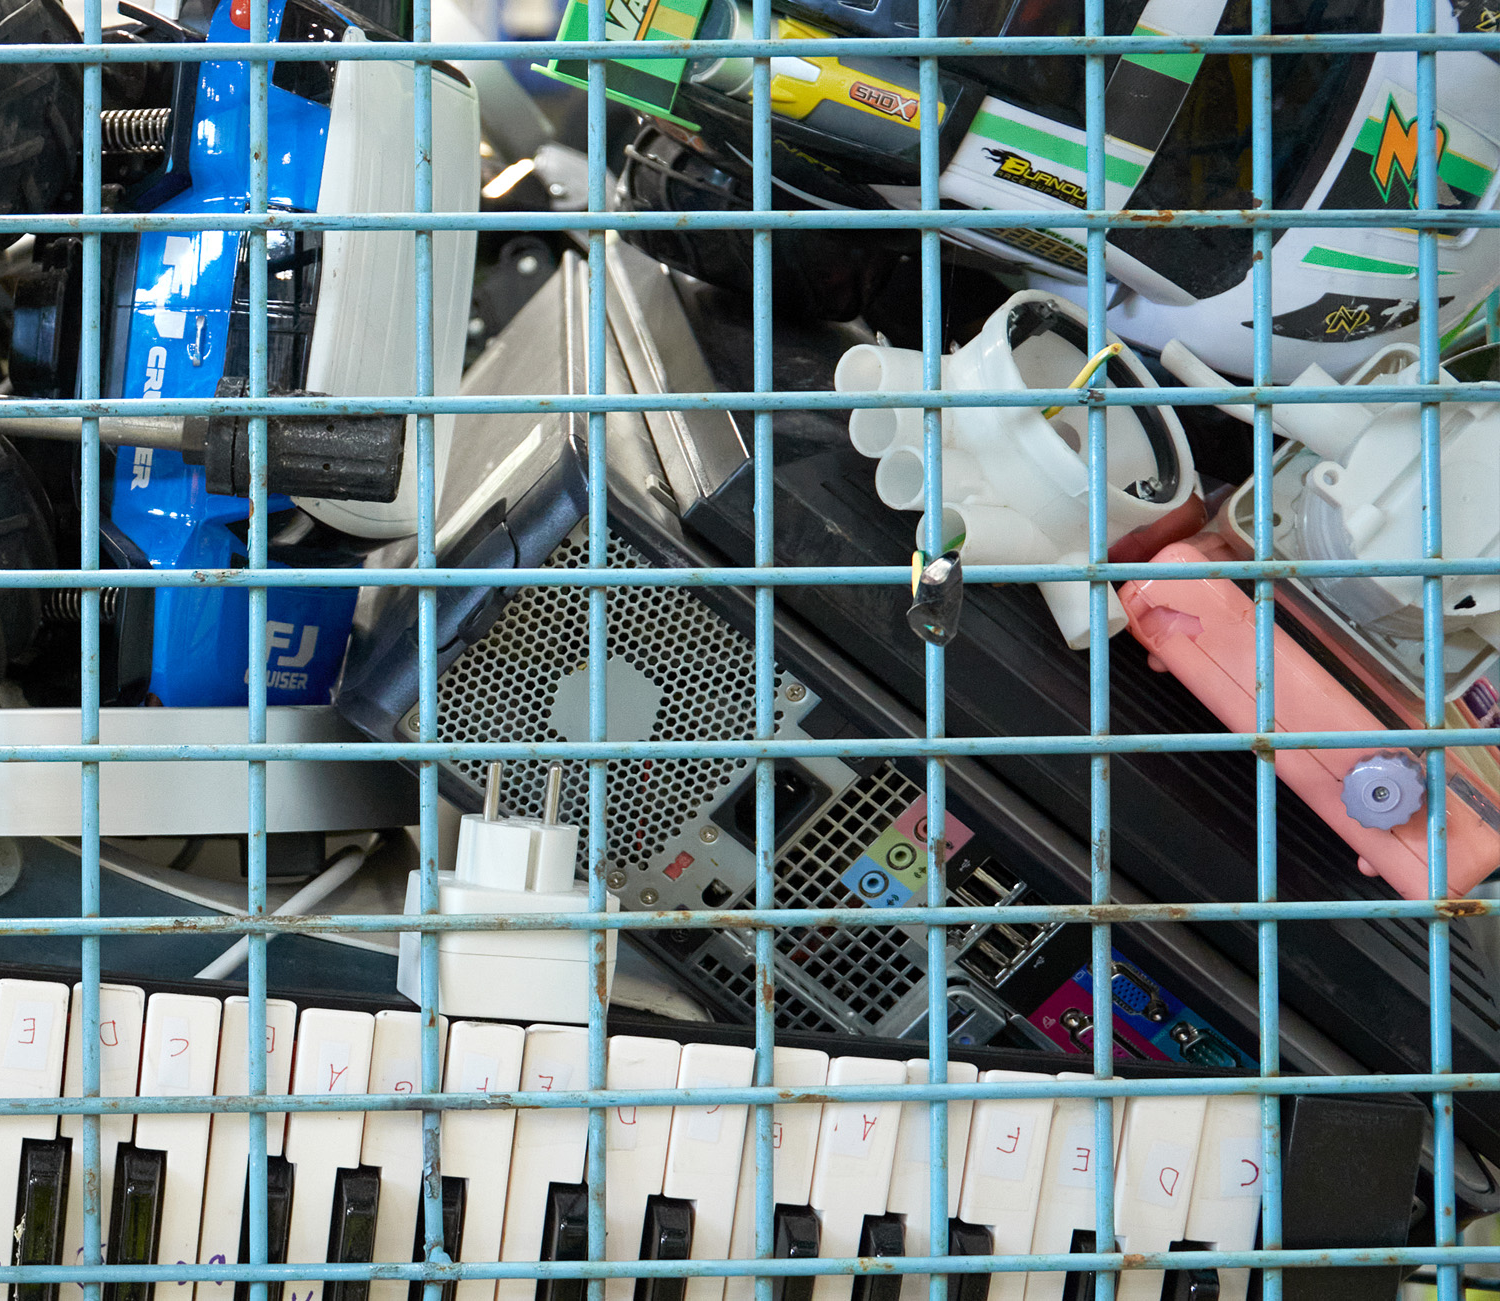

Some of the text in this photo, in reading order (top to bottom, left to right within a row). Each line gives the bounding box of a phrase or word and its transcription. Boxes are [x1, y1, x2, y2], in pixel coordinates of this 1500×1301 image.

[855, 85, 918, 120] SHOX
[1000, 156, 1088, 200] BURNOU
[1029, 180, 1088, 208] SUPPLIER
[129, 345, 169, 491] CRER
[265, 620, 320, 668] FJ
[244, 667, 309, 690] UISER
[17, 1017, 37, 1045] E
[328, 1063, 349, 1092] A
[862, 1114, 877, 1142] A
[996, 1127, 1021, 1154] F
[1073, 1147, 1091, 1172] E
[1159, 1166, 1180, 1197] D
[1240, 1158, 1260, 1187] C
